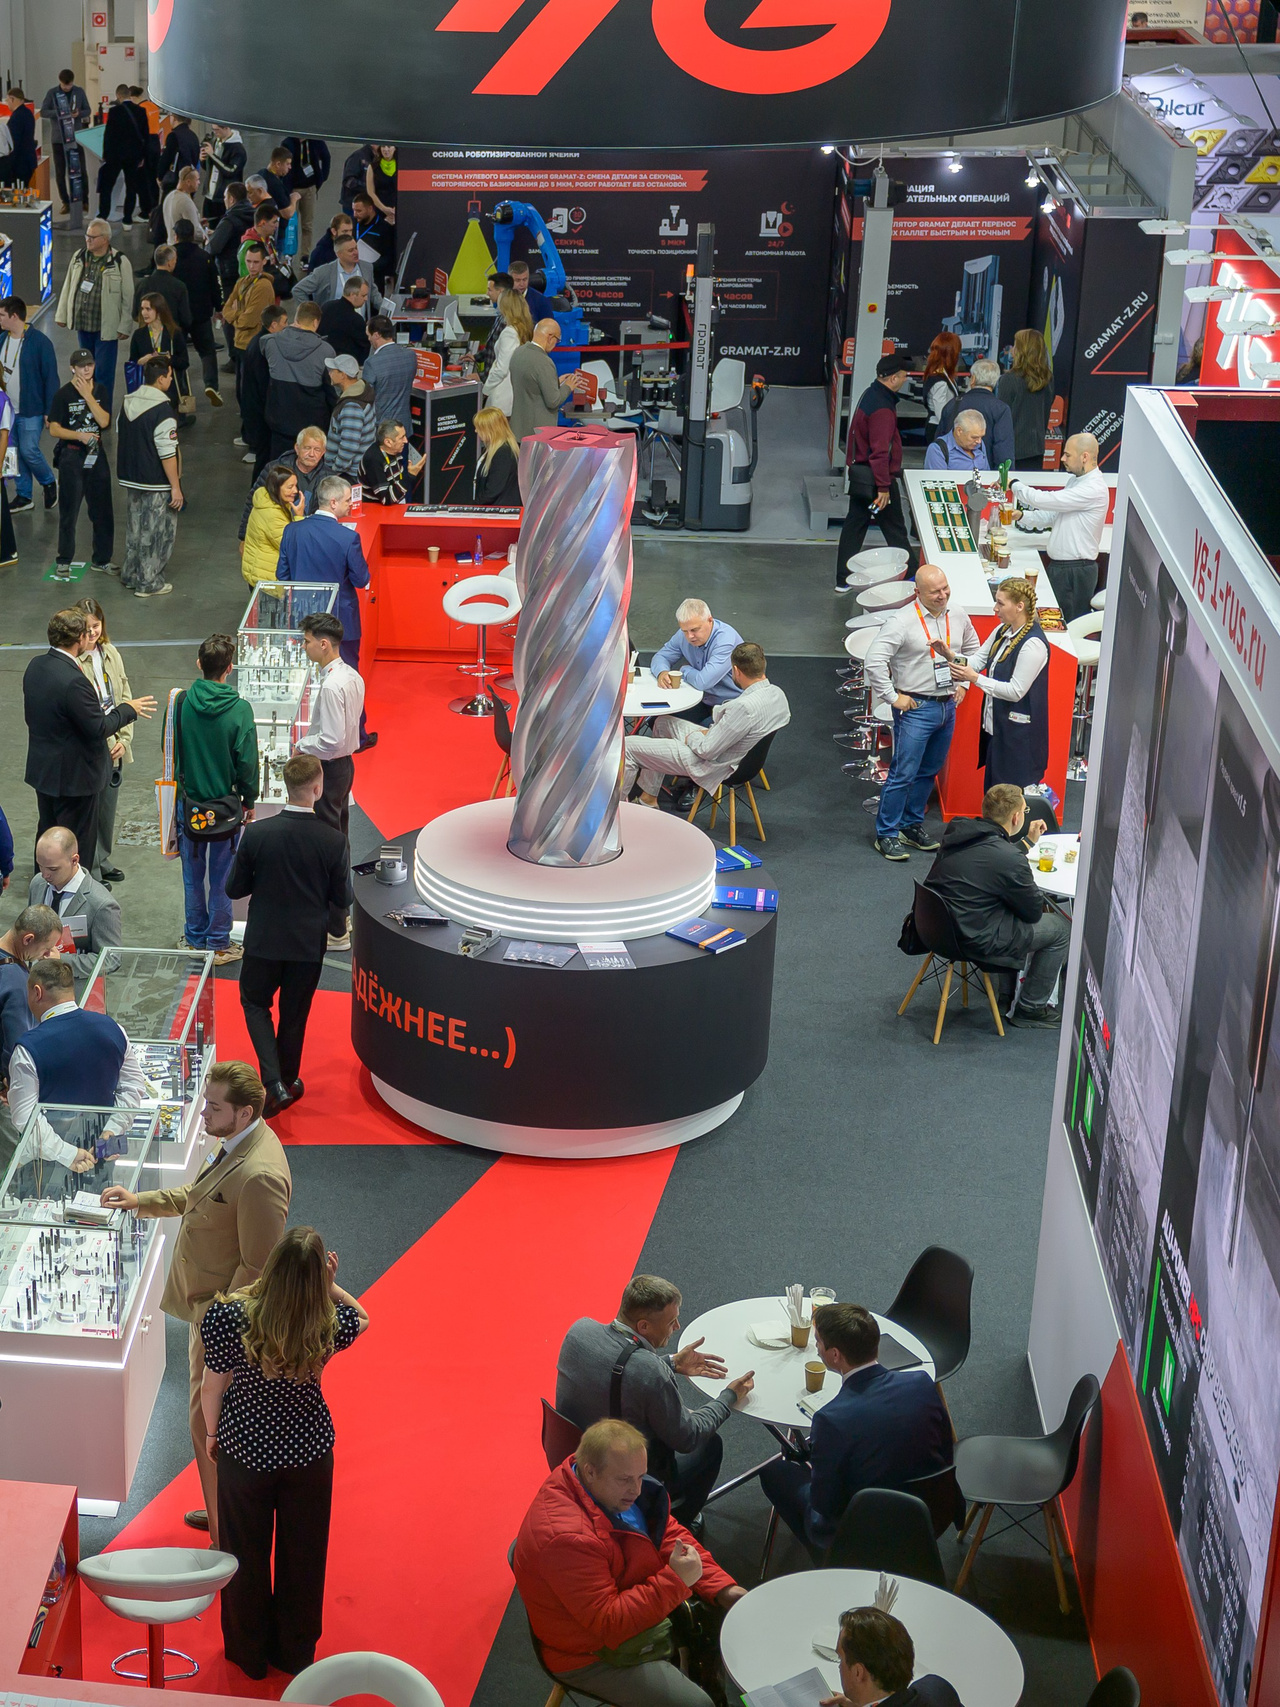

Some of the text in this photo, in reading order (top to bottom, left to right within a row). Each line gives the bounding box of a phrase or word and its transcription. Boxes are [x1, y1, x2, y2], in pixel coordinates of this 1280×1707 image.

[649, 174, 683, 182] СЕКУНДЫ,
[539, 181, 549, 189] ДО
[906, 184, 935, 194] АЦИЯ
[906, 193, 1010, 204] АТЕЛЬНЫХ ОПЕРАЦИЙ
[951, 221, 980, 229] ДЕЛАЕТ
[1083, 291, 1150, 361] GRAMAT-Z.RU
[720, 346, 801, 356] GRAMAT-Z.RU
[437, 414, 456, 422] СИСТЕМА
[1091, 412, 1117, 436] ЛЕВОГО
[1098, 414, 1125, 446] ЗИРОВА
[1191, 527, 1268, 692] yg-1-rus.ru
[1161, 1208, 1192, 1308] ALU-POWER
[1200, 1327, 1216, 1386] CHIP
[1163, 1351, 1174, 1402] N
